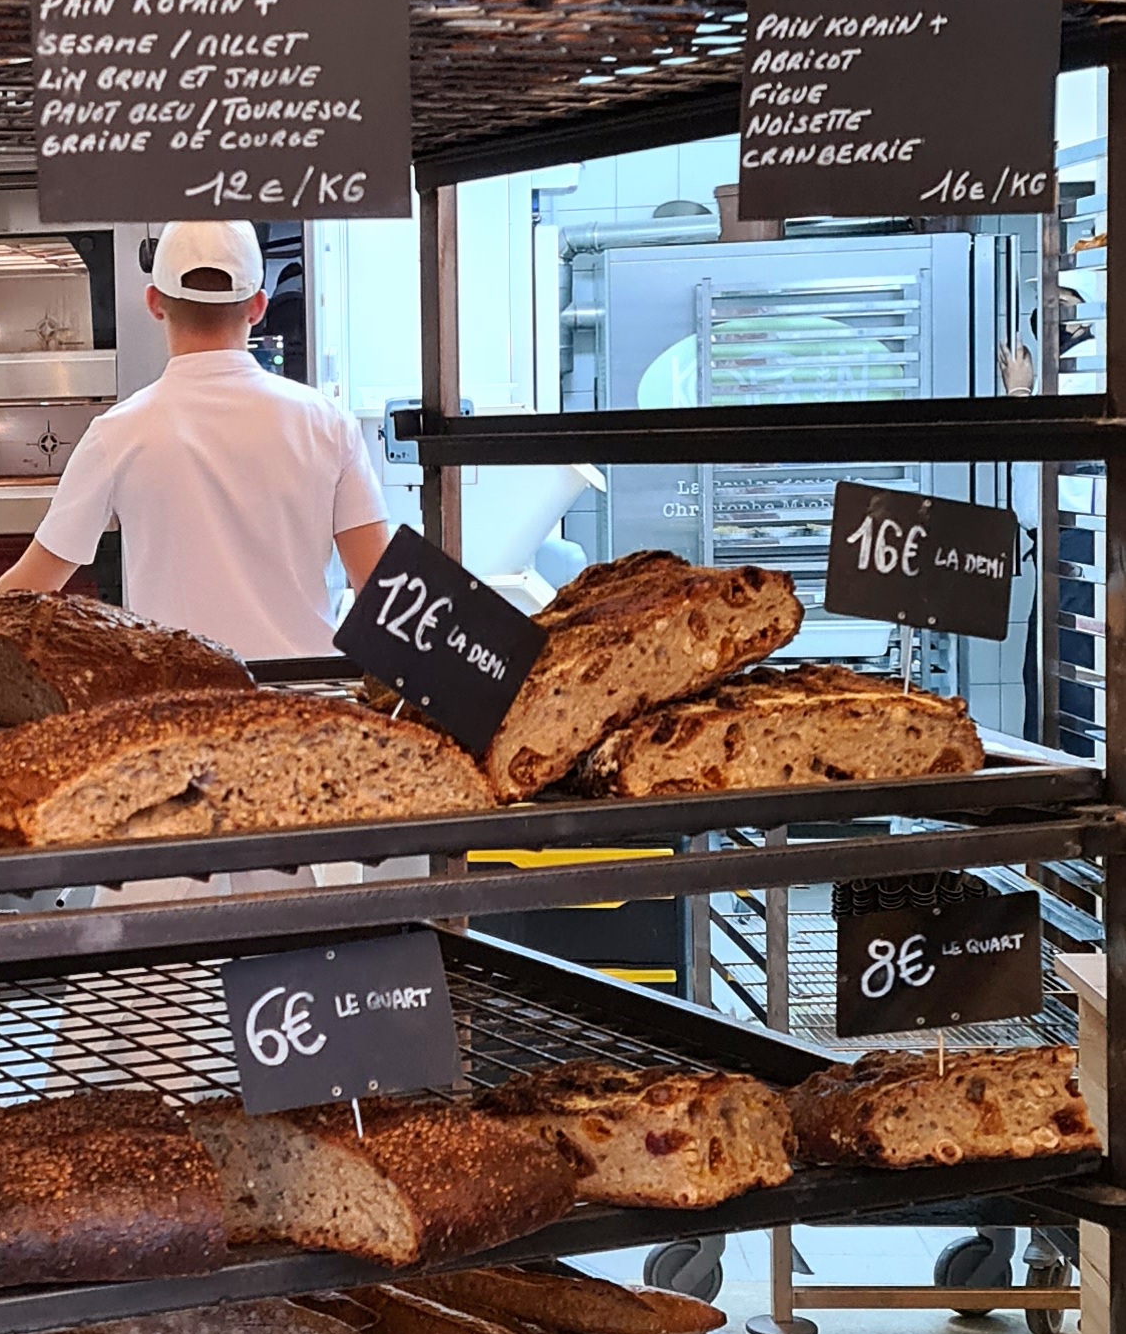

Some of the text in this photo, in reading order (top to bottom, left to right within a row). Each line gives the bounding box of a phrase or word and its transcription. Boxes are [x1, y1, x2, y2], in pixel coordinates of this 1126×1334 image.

[755, 12, 949, 41] PAIN KOPAIN +
[36, 33, 159, 56] SESAME
[750, 47, 862, 74] ABRICOT
[38, 65, 322, 92] LIN BRUN ET JAUNE
[748, 81, 828, 108] FIGUE
[40, 100, 122, 127] PAVOT
[41, 128, 325, 157] GRAINE DE COURGE
[846, 515, 927, 577] 16€
[934, 547, 959, 571] LA
[377, 572, 454, 652] 12€
[446, 624, 467, 654] LA
[860, 933, 1025, 999] 8€ LE QUART
[245, 986, 433, 1067] 6€ LE QUART
